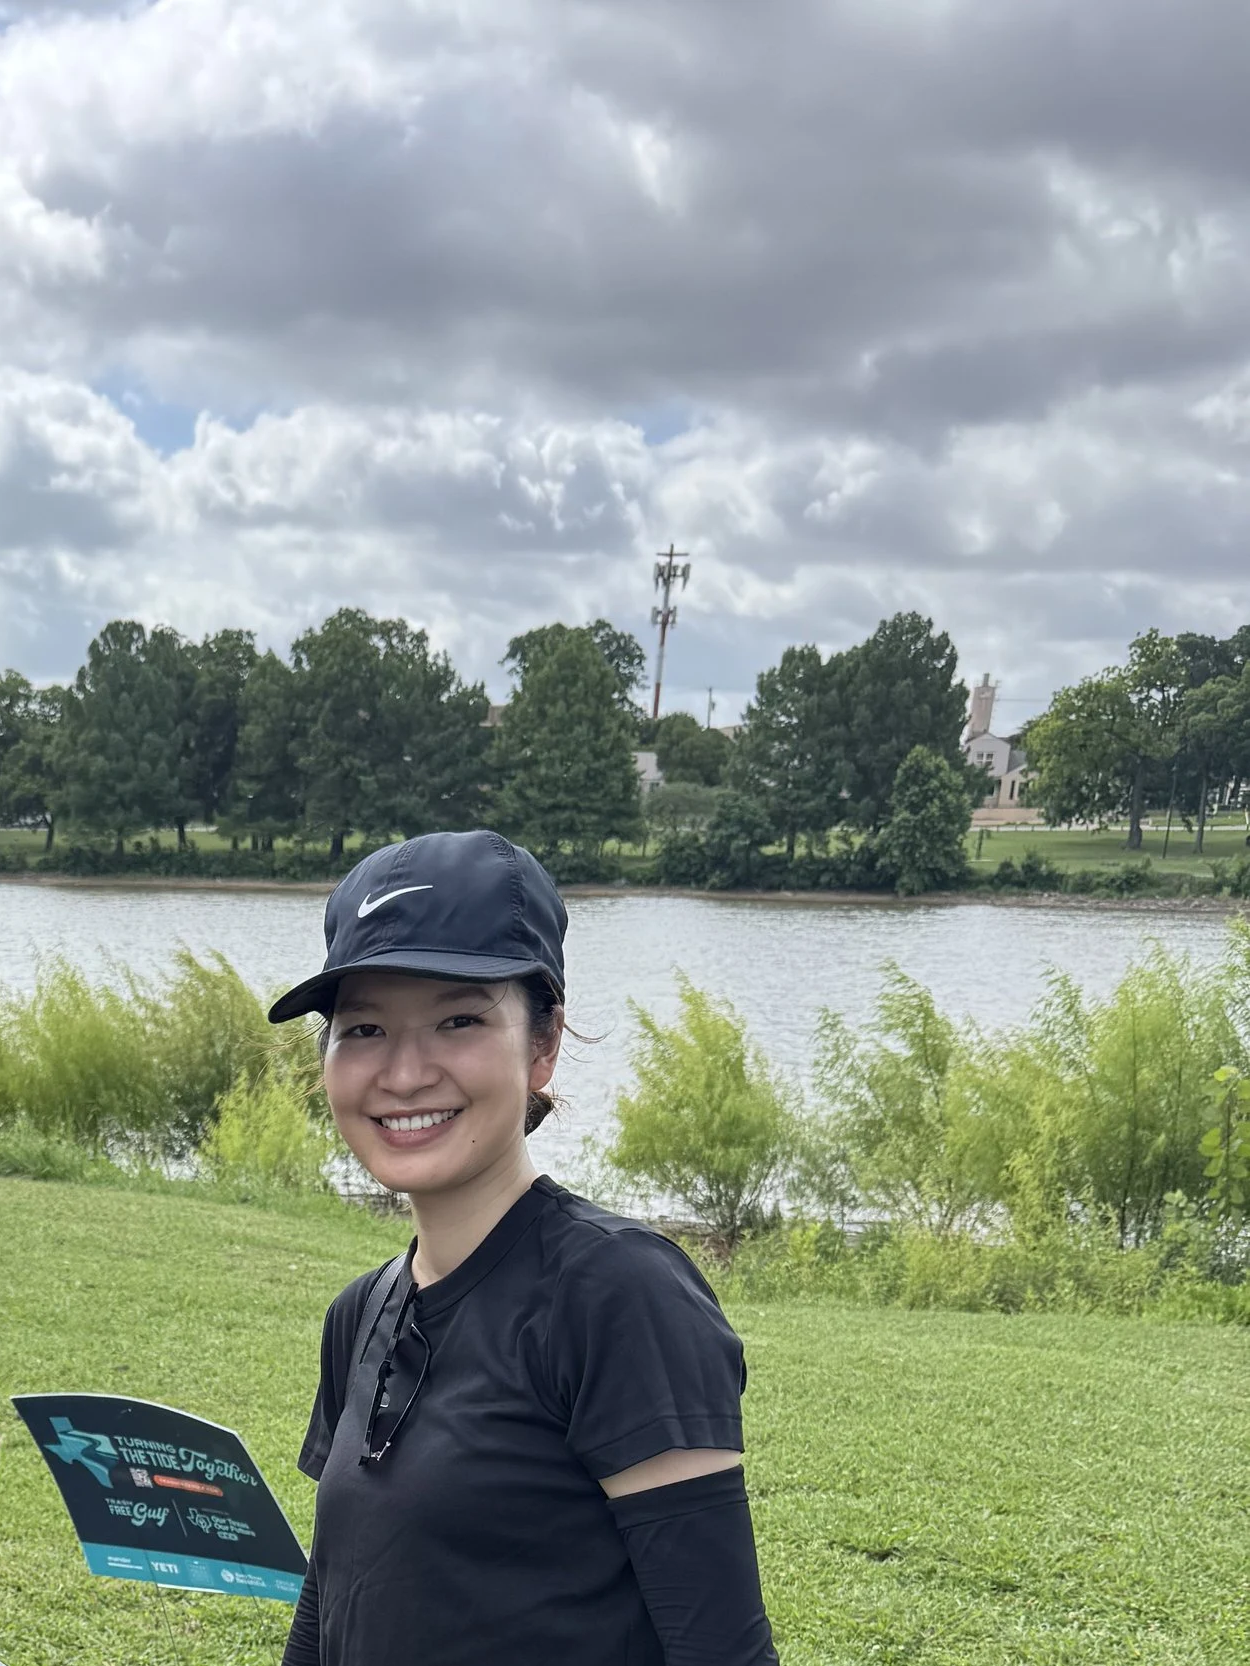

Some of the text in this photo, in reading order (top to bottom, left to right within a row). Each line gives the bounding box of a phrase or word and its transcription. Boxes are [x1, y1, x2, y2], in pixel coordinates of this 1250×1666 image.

[114, 1435, 176, 1454] TURNING
[119, 1447, 150, 1466] THE
[149, 1450, 182, 1471] TIDE
[178, 1447, 258, 1487] Together
[108, 1502, 170, 1527] FREE Gulf
[151, 1561, 179, 1574] YETI
